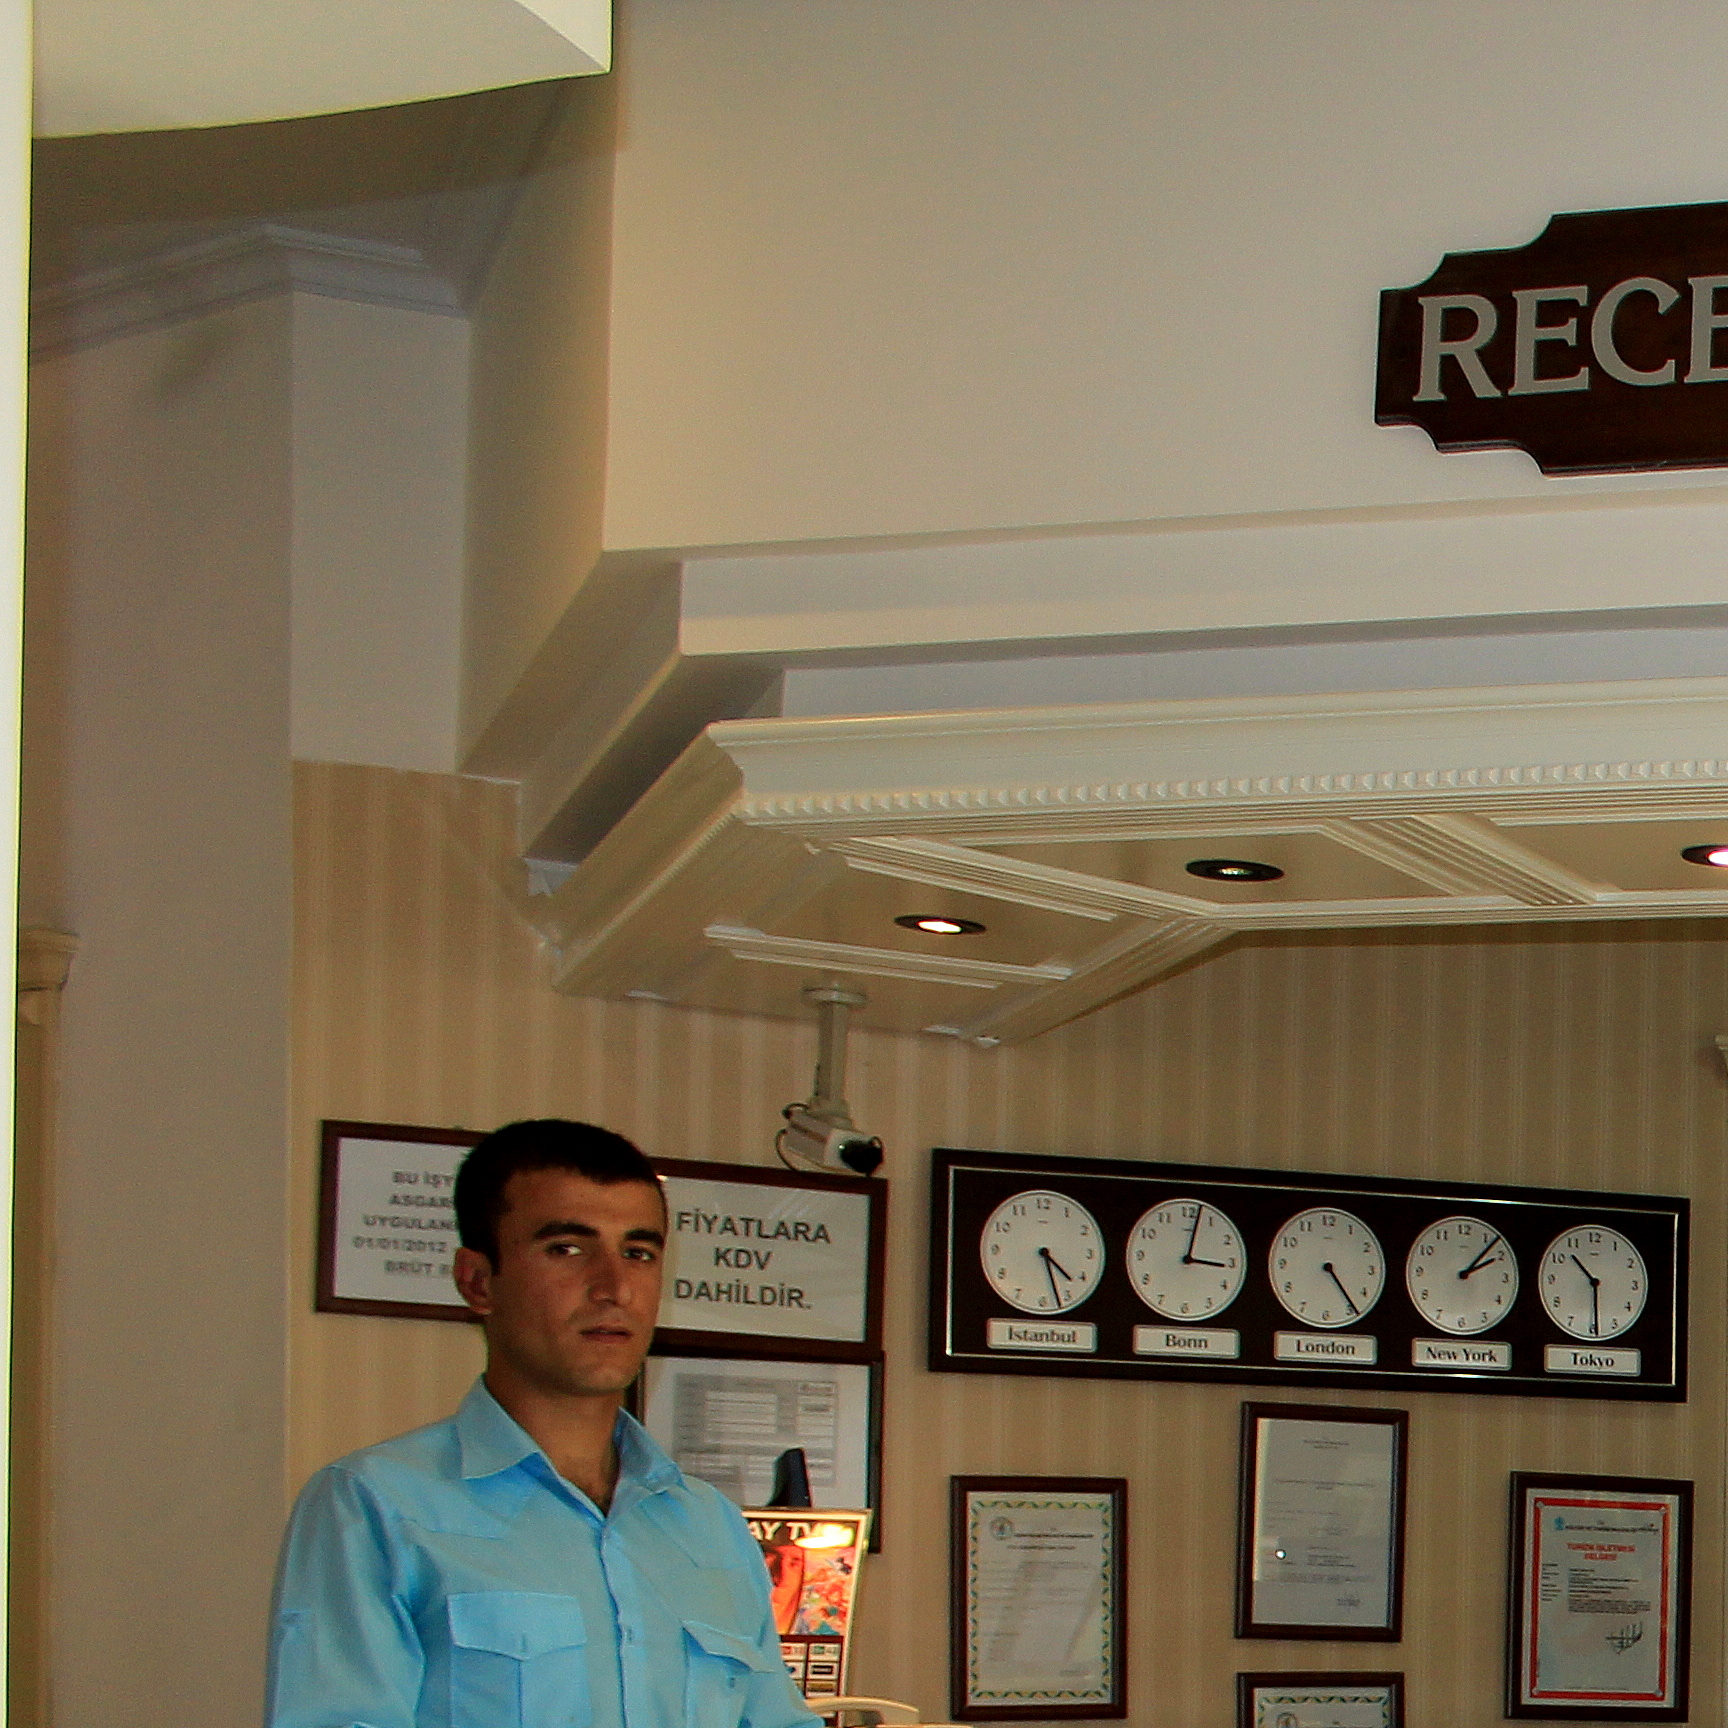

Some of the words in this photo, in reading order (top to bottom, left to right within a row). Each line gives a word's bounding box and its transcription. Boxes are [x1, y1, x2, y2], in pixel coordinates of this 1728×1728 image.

[675, 1208, 832, 1245] FİYATLARA
[714, 1247, 772, 1270] KDV
[674, 1278, 812, 1310] DAHİLDİR.
[1165, 1333, 1208, 1349] Bonn
[1296, 1338, 1355, 1356] London
[1426, 1347, 1458, 1360] New
[1462, 1348, 1497, 1363] York
[1571, 1352, 1615, 1368] Tokyo
